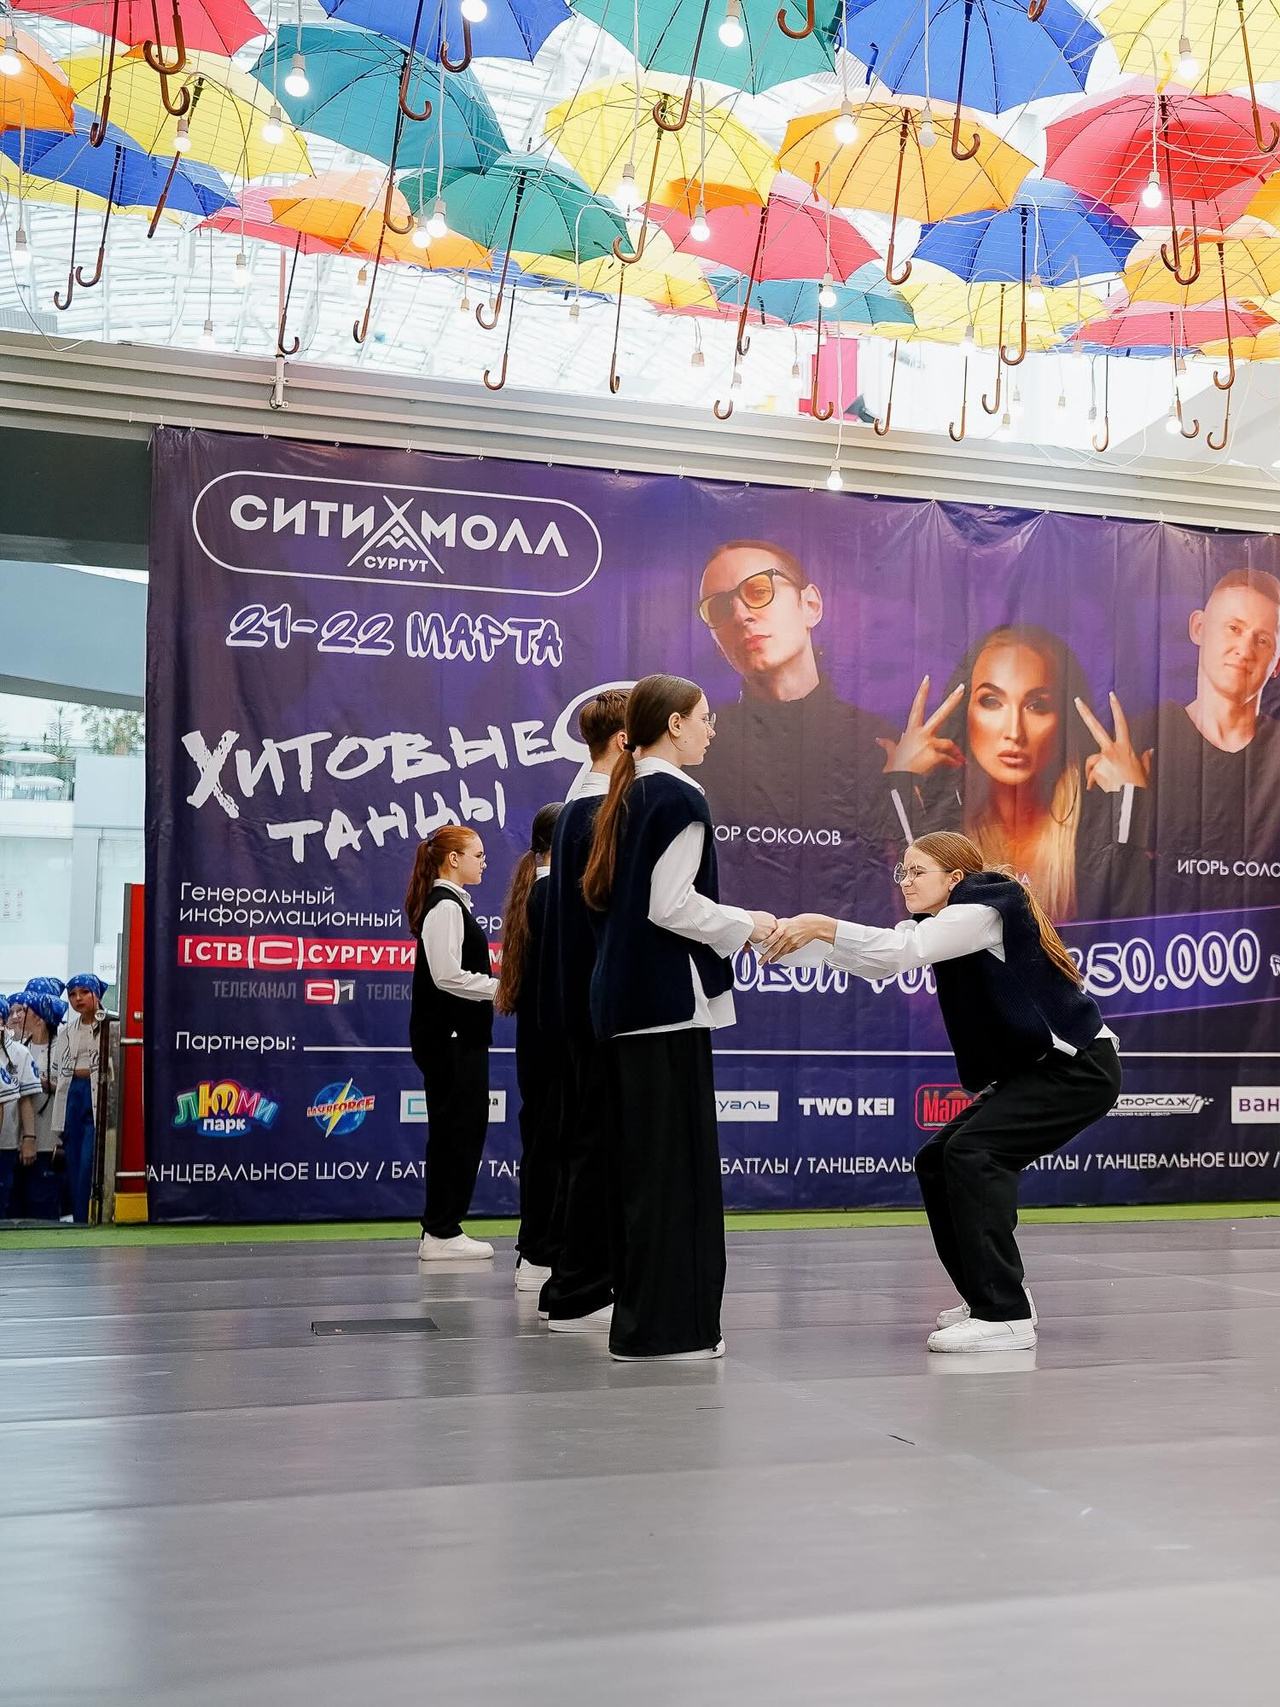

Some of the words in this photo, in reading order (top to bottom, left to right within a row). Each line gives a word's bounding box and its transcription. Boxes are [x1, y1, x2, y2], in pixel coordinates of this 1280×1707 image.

[230, 494, 374, 538] СИТИ
[422, 510, 569, 556] МОЛЛ
[364, 555, 429, 573] СУРГУТ
[226, 603, 394, 656] 21-22
[406, 611, 563, 667] МАРТА
[181, 720, 555, 818] ХИТОВЫЕ
[266, 780, 505, 863] ТАНЦЫ
[713, 825, 741, 842] ОР
[746, 826, 842, 846] СОКОЛОВ
[1177, 859, 1230, 876] ИГОРЬ
[180, 882, 335, 906] Генеральный
[179, 904, 402, 928] информационный
[307, 944, 416, 965] СУРГУТИ
[212, 980, 297, 999] ТЕЛЕКАНАЛ
[366, 983, 412, 1001] ТЕЛЕК
[175, 1031, 297, 1055] Партнеры:
[307, 1095, 376, 1118] LASERFORCE
[716, 1100, 770, 1112] уаль
[799, 1098, 853, 1116] TWO
[858, 1098, 894, 1116] KEI
[923, 1090, 973, 1122] Мал
[1120, 1097, 1191, 1106] ФОРСАЖ
[202, 1119, 246, 1134] парк
[316, 1161, 369, 1181] ШОУ
[391, 1161, 427, 1180] БАТ
[720, 1158, 788, 1175] БАТТЛЫ
[1021, 1154, 1079, 1171] АТТЛЫ
[1095, 1152, 1224, 1170] ТАНЦЕВАЛЬНОЕ
[1229, 1152, 1270, 1168] ШОУ
